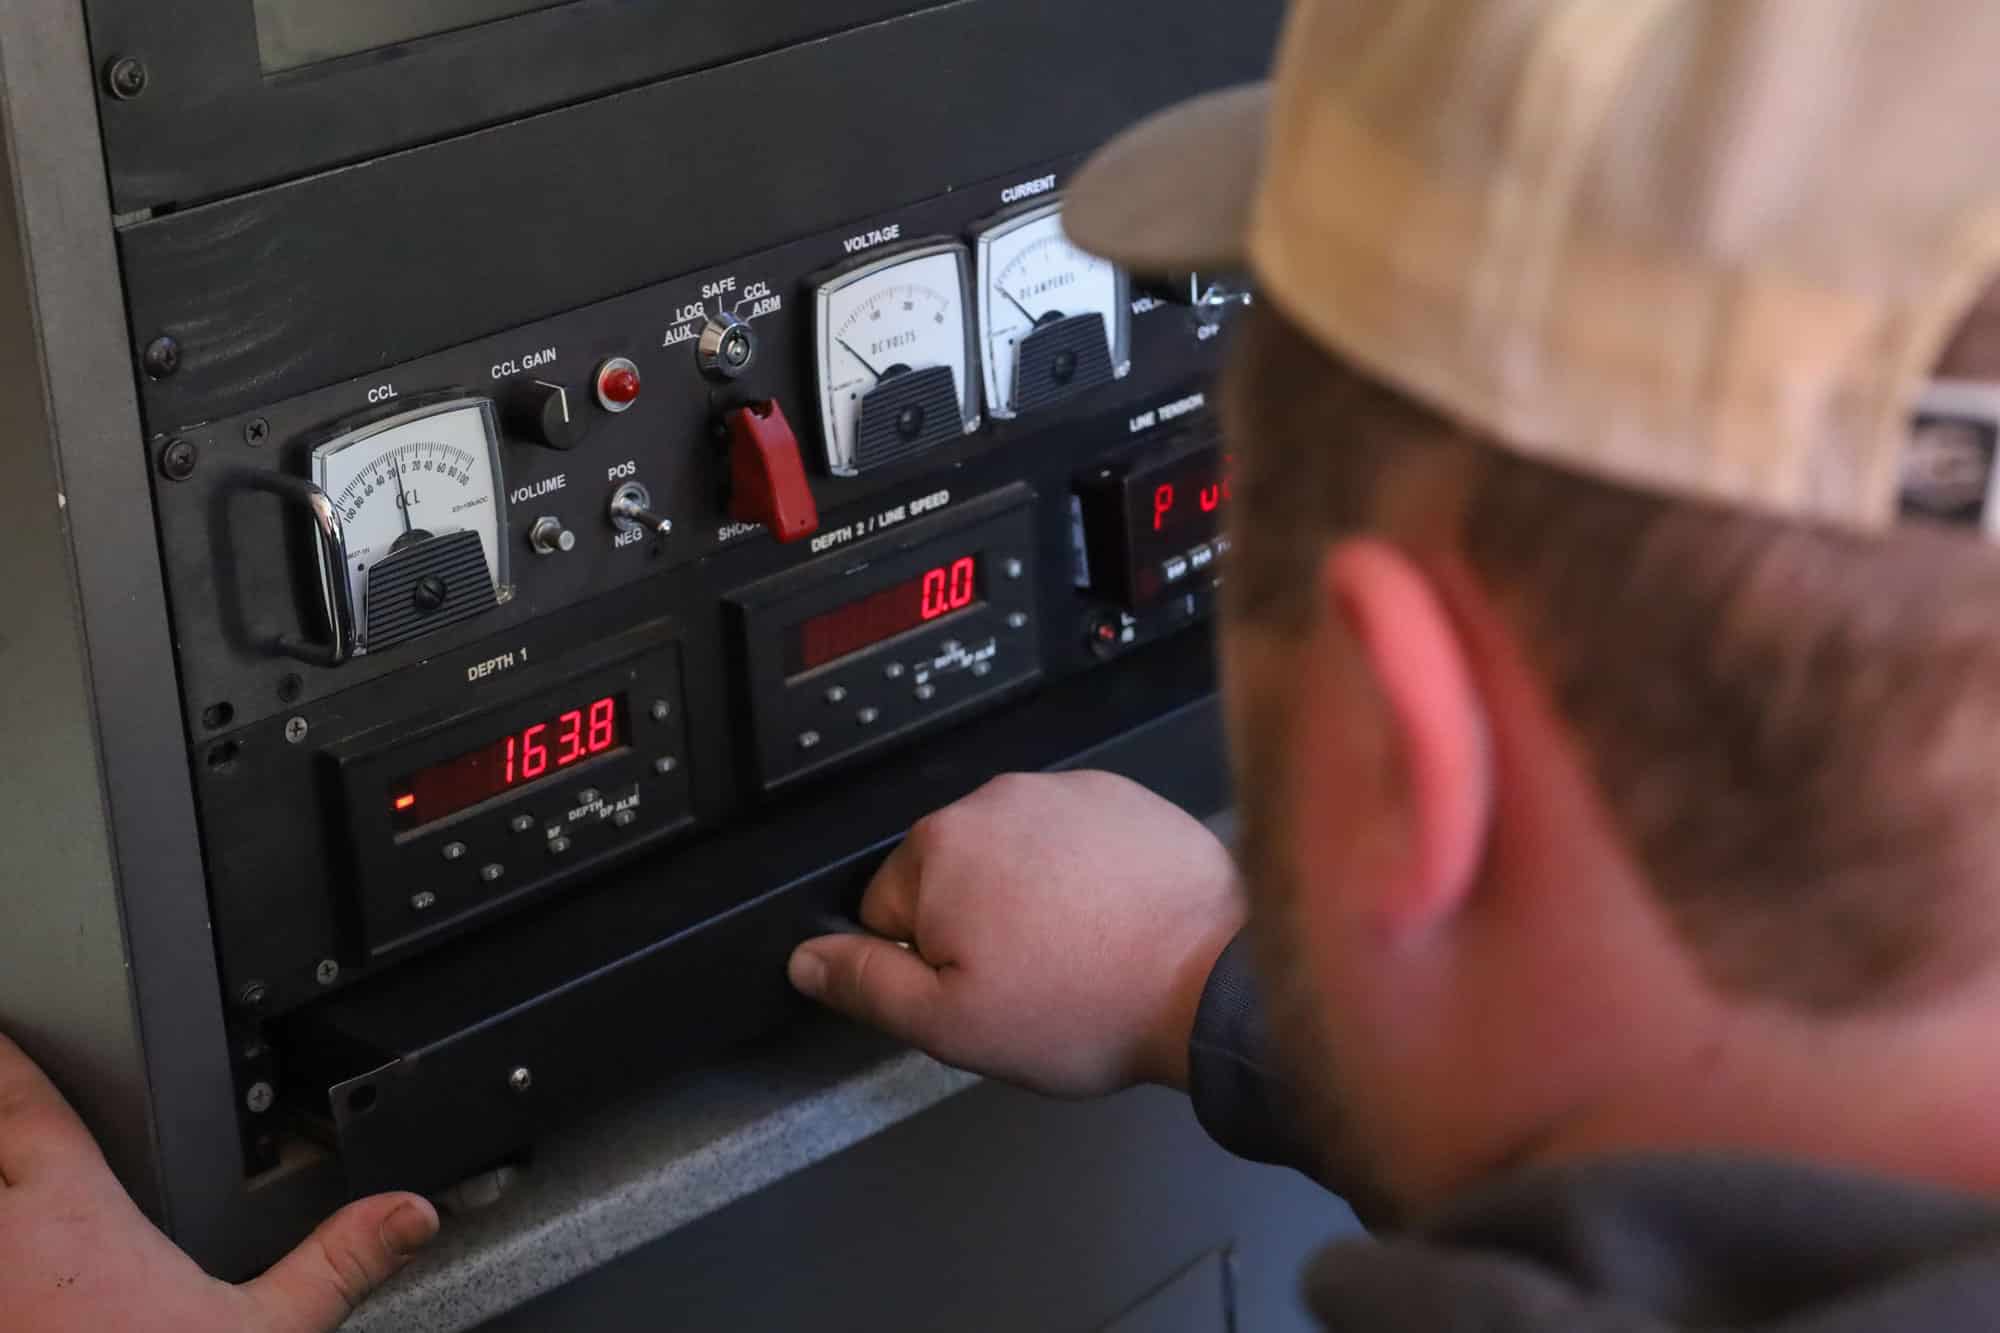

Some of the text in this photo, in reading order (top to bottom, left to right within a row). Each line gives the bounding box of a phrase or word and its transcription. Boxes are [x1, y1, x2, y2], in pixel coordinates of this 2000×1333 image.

[1001, 174, 1056, 203] CURRENT
[843, 224, 900, 253] VOLTAGE
[701, 277, 737, 299] SAFE
[744, 280, 771, 301] CCL
[676, 301, 704, 323] LOG
[752, 295, 781, 317] ARM
[664, 324, 692, 344] AUX
[491, 347, 557, 379] CCL GAIN
[368, 384, 398, 403] CCL
[1130, 411, 1155, 432] LINE
[608, 460, 636, 481] POS
[344, 460, 470, 524] 100 80 60 40 20 0 20 40 60 80 100
[396, 489, 420, 510] CCL
[510, 474, 567, 505] VOLUME
[718, 522, 761, 541] SHO
[811, 489, 950, 552] DEPTH 2 / LINE SPEED
[614, 527, 643, 548] NEG
[921, 556, 975, 620] 0.0
[468, 647, 528, 682] DEPTH 1
[505, 697, 615, 784] 163.8
[568, 799, 603, 821] DEPTH
